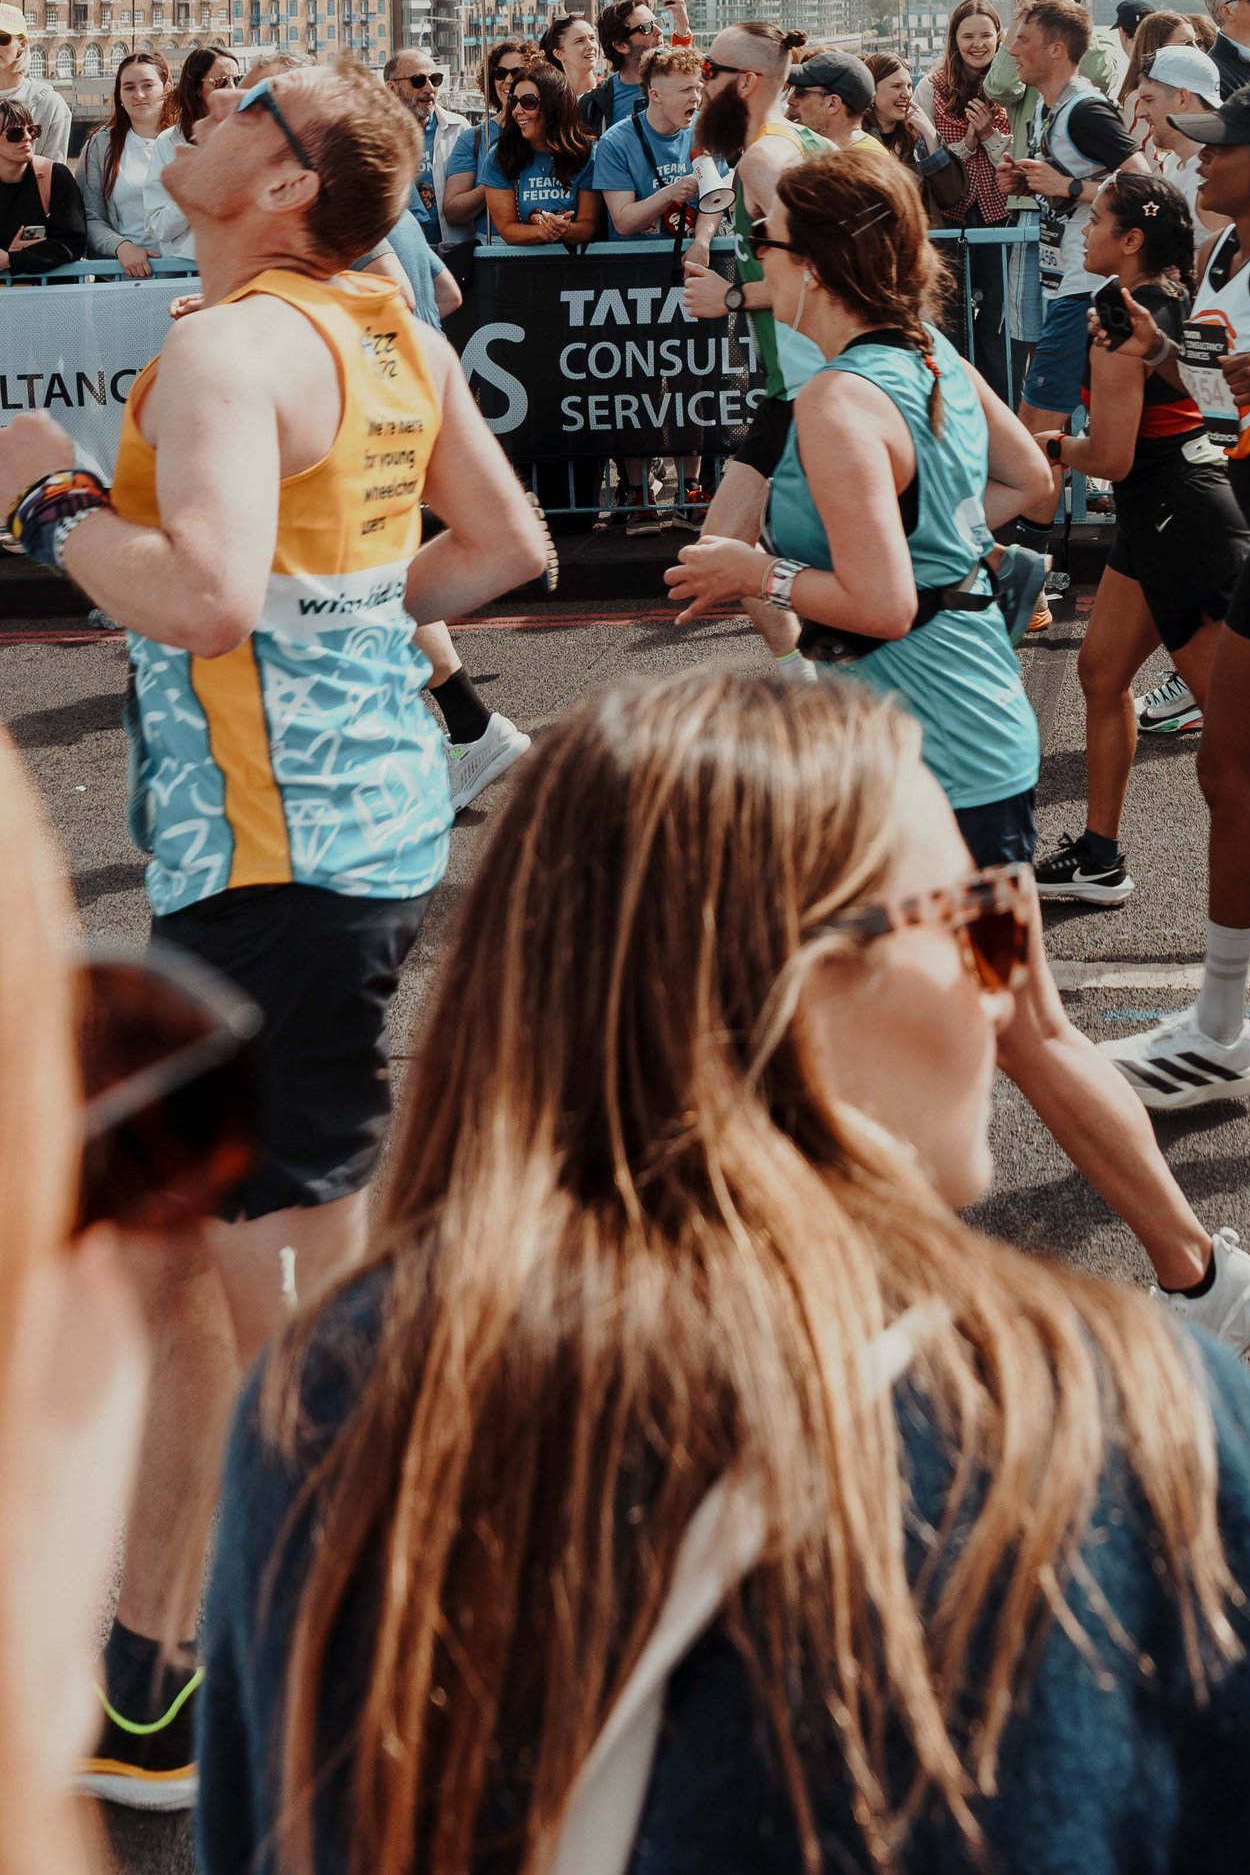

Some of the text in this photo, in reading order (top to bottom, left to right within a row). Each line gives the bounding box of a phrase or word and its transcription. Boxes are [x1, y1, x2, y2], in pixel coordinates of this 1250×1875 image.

[652, 174, 683, 189] FLTO
[656, 163, 687, 174] TEAM
[523, 189, 571, 202] FELTON
[559, 286, 700, 327] TATA
[559, 336, 760, 381] CONSULT
[0, 368, 145, 410] LTANC
[560, 388, 768, 432] SERVICES
[379, 449, 416, 472] young
